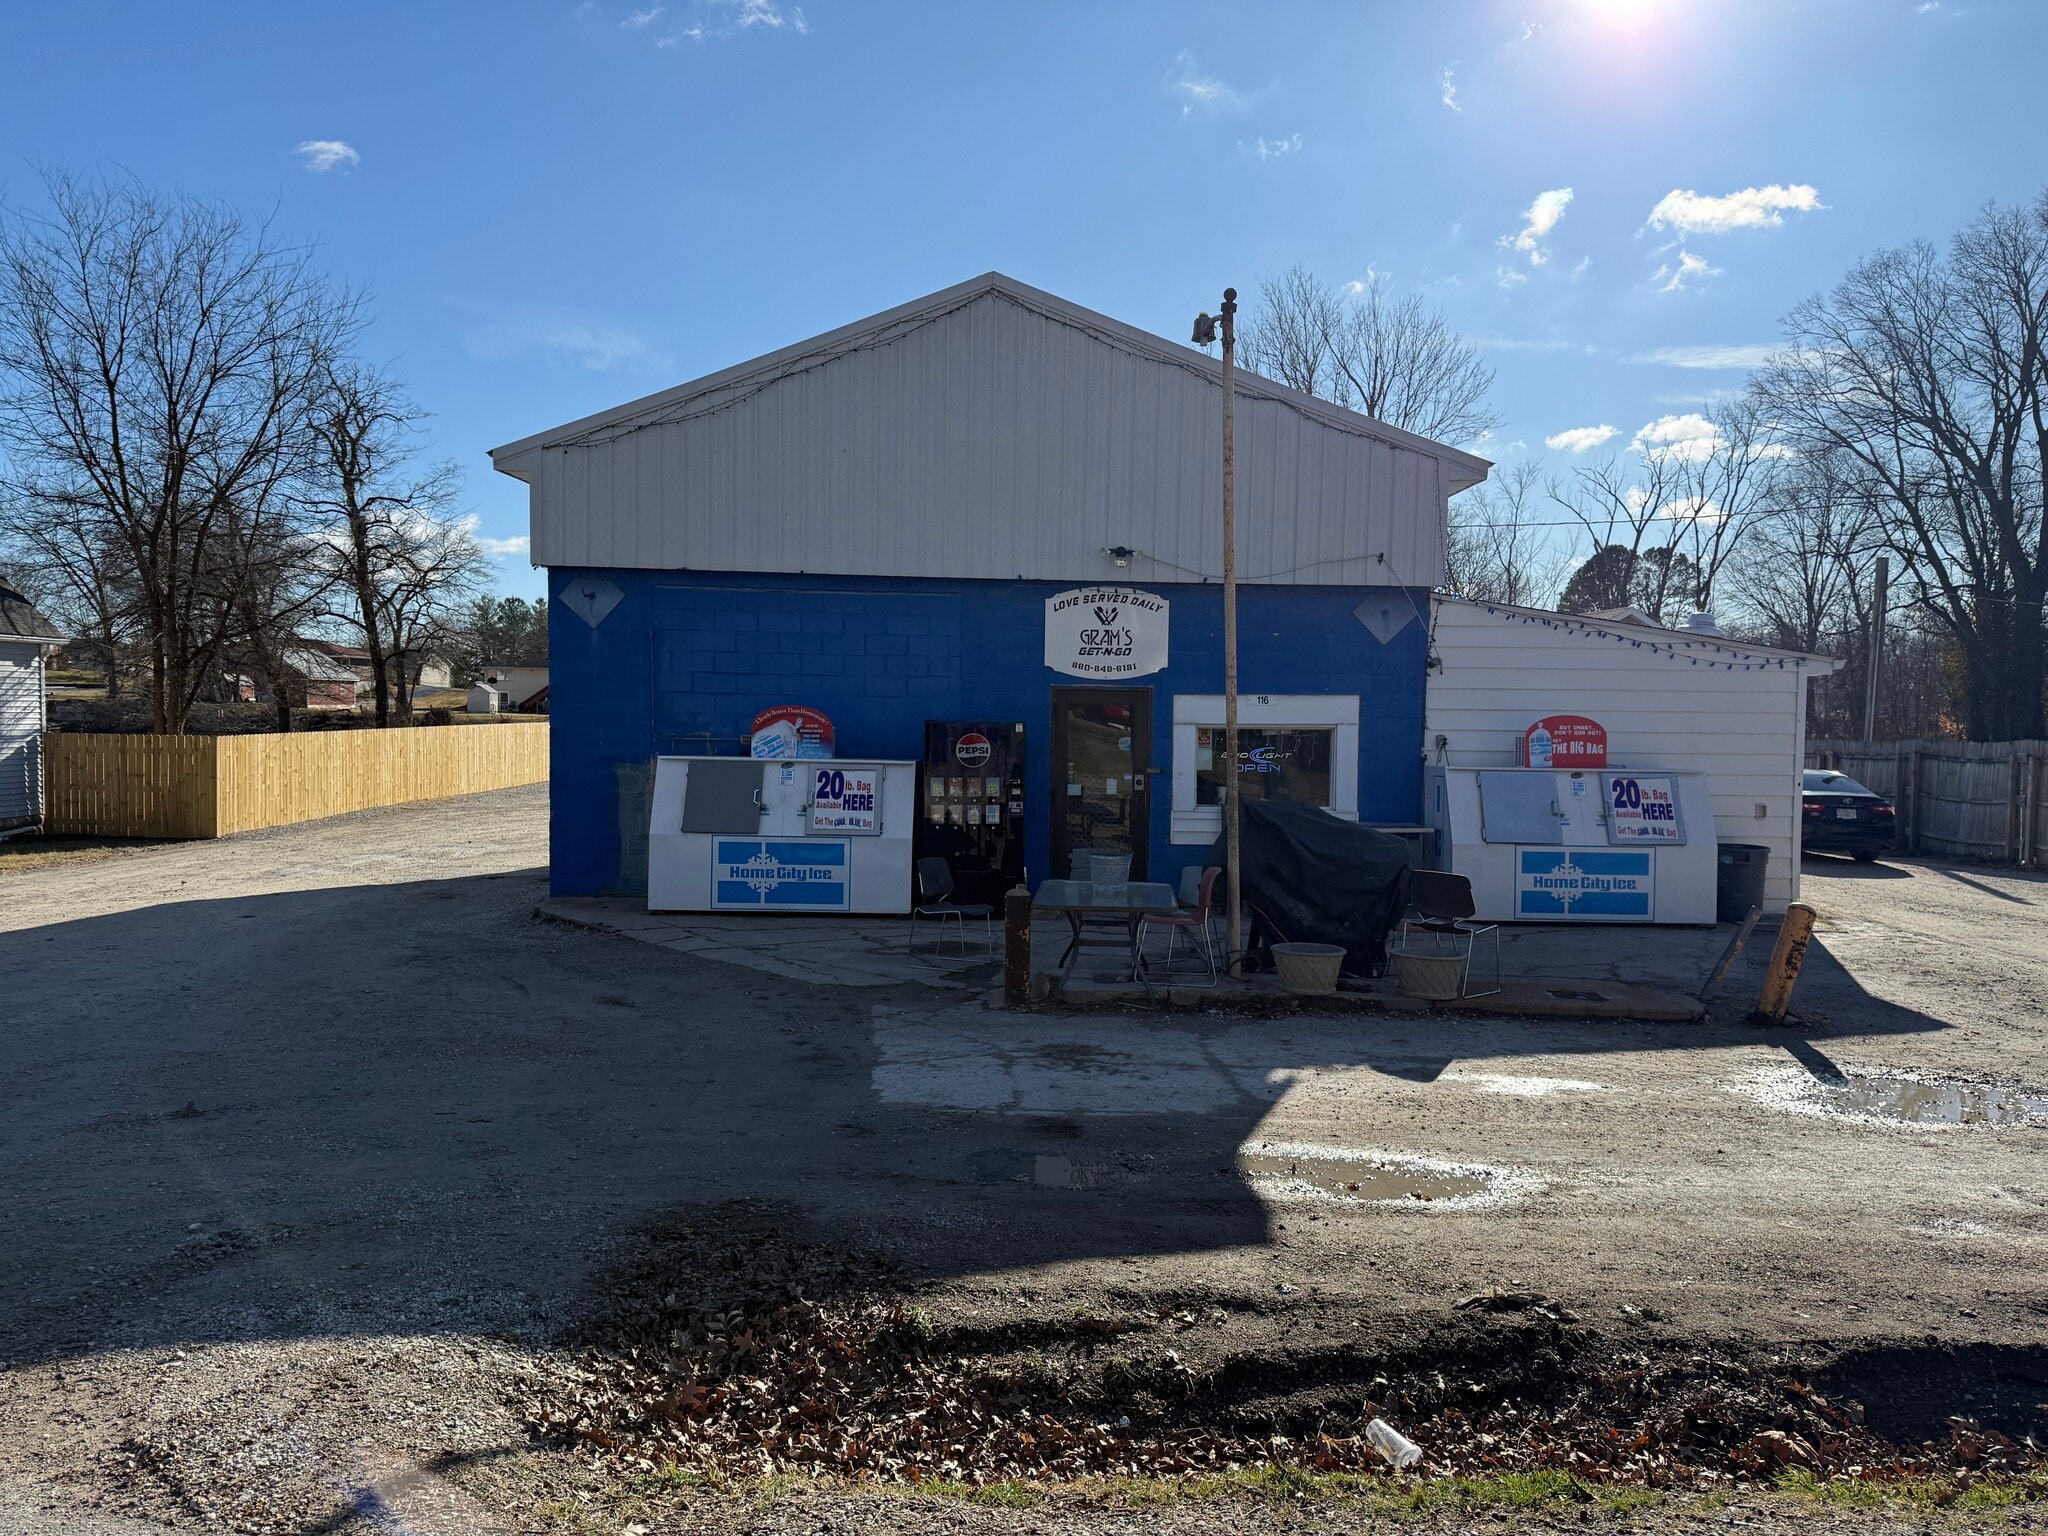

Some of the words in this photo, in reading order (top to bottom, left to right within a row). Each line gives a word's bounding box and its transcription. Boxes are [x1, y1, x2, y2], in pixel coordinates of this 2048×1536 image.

[1054, 596, 1079, 612] LOVE
[1083, 594, 1128, 604] SERVED
[1130, 597, 1164, 612] DAILY
[1080, 626, 1133, 646] GRAM'S
[1078, 647, 1132, 656] GET-N-GO
[1257, 696, 1269, 704] 116
[755, 712, 771, 724] Clearly
[800, 708, 829, 726] Homemade!
[958, 746, 988, 754] PEPSI
[1552, 743, 1567, 754] THE
[1570, 741, 1584, 754] BIG
[1586, 742, 1604, 754] BAG
[816, 770, 844, 800] 20
[845, 780, 854, 790] lb.
[857, 780, 871, 793] Bag
[1612, 780, 1641, 809] 20
[1641, 789, 1651, 800] lb.
[1653, 790, 1668, 802] Bag
[816, 801, 842, 809] Available
[842, 794, 874, 811] HERE
[1616, 810, 1642, 818] Available
[1641, 803, 1674, 820] HERE
[815, 817, 824, 825] Get
[824, 817, 833, 825] The
[834, 817, 847, 827] COOL
[849, 818, 862, 827] BLUE
[863, 819, 872, 828] Bag
[1617, 826, 1627, 834] Get
[1627, 827, 1637, 835] The
[1638, 827, 1651, 836] COOL
[1652, 827, 1666, 837] BLUE
[1666, 829, 1676, 838] Bag
[730, 866, 774, 878] Home
[777, 867, 807, 881] City
[809, 868, 832, 879] Ice
[1533, 876, 1578, 888] Home
[1581, 877, 1610, 891] City
[1613, 877, 1636, 890] Ice
